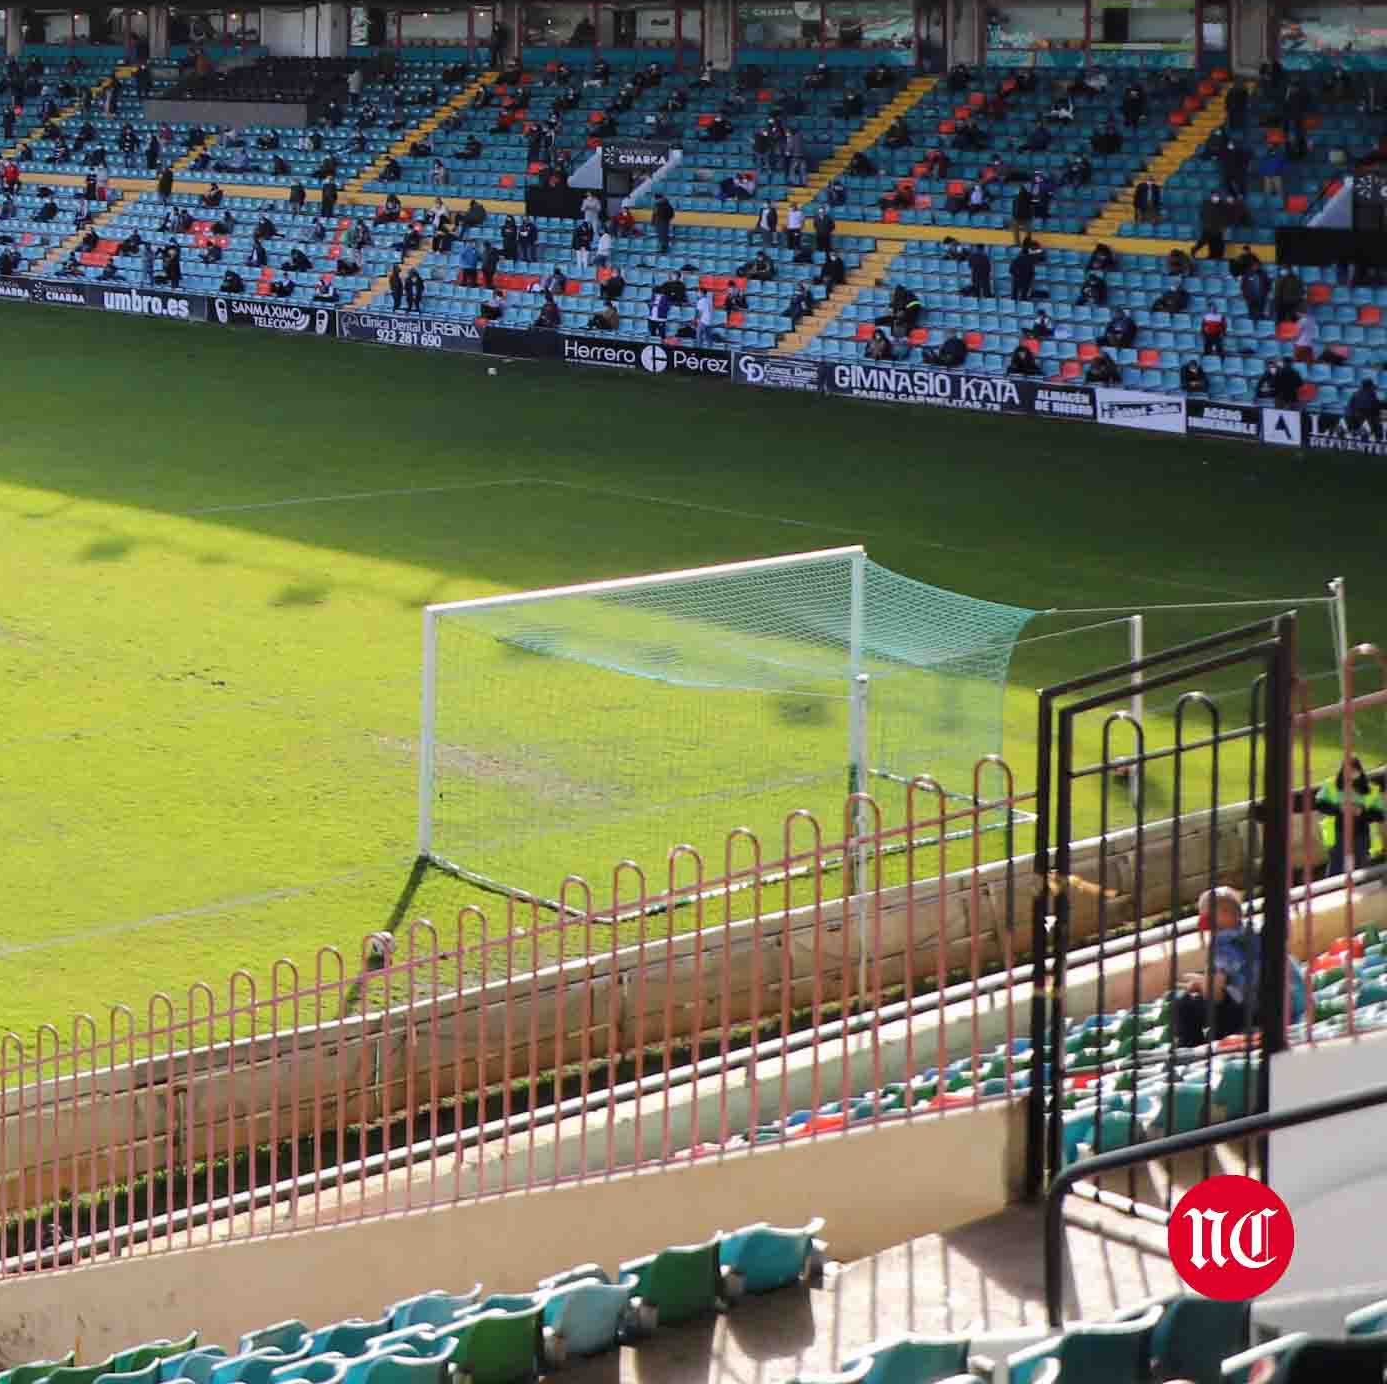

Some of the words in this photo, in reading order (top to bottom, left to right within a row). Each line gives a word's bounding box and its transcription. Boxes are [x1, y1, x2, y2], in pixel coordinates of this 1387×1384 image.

[619, 155, 667, 166] CHARRA
[46, 291, 86, 304] CHARRA
[103, 289, 190, 318] umbro.es
[253, 315, 297, 330] TELECOM
[391, 318, 422, 333] Dental
[421, 320, 482, 339] URBINA
[564, 338, 636, 364] Herrero
[673, 349, 728, 373] Pérez
[833, 364, 952, 398] GIMNASIO
[960, 376, 1020, 405] KATA
